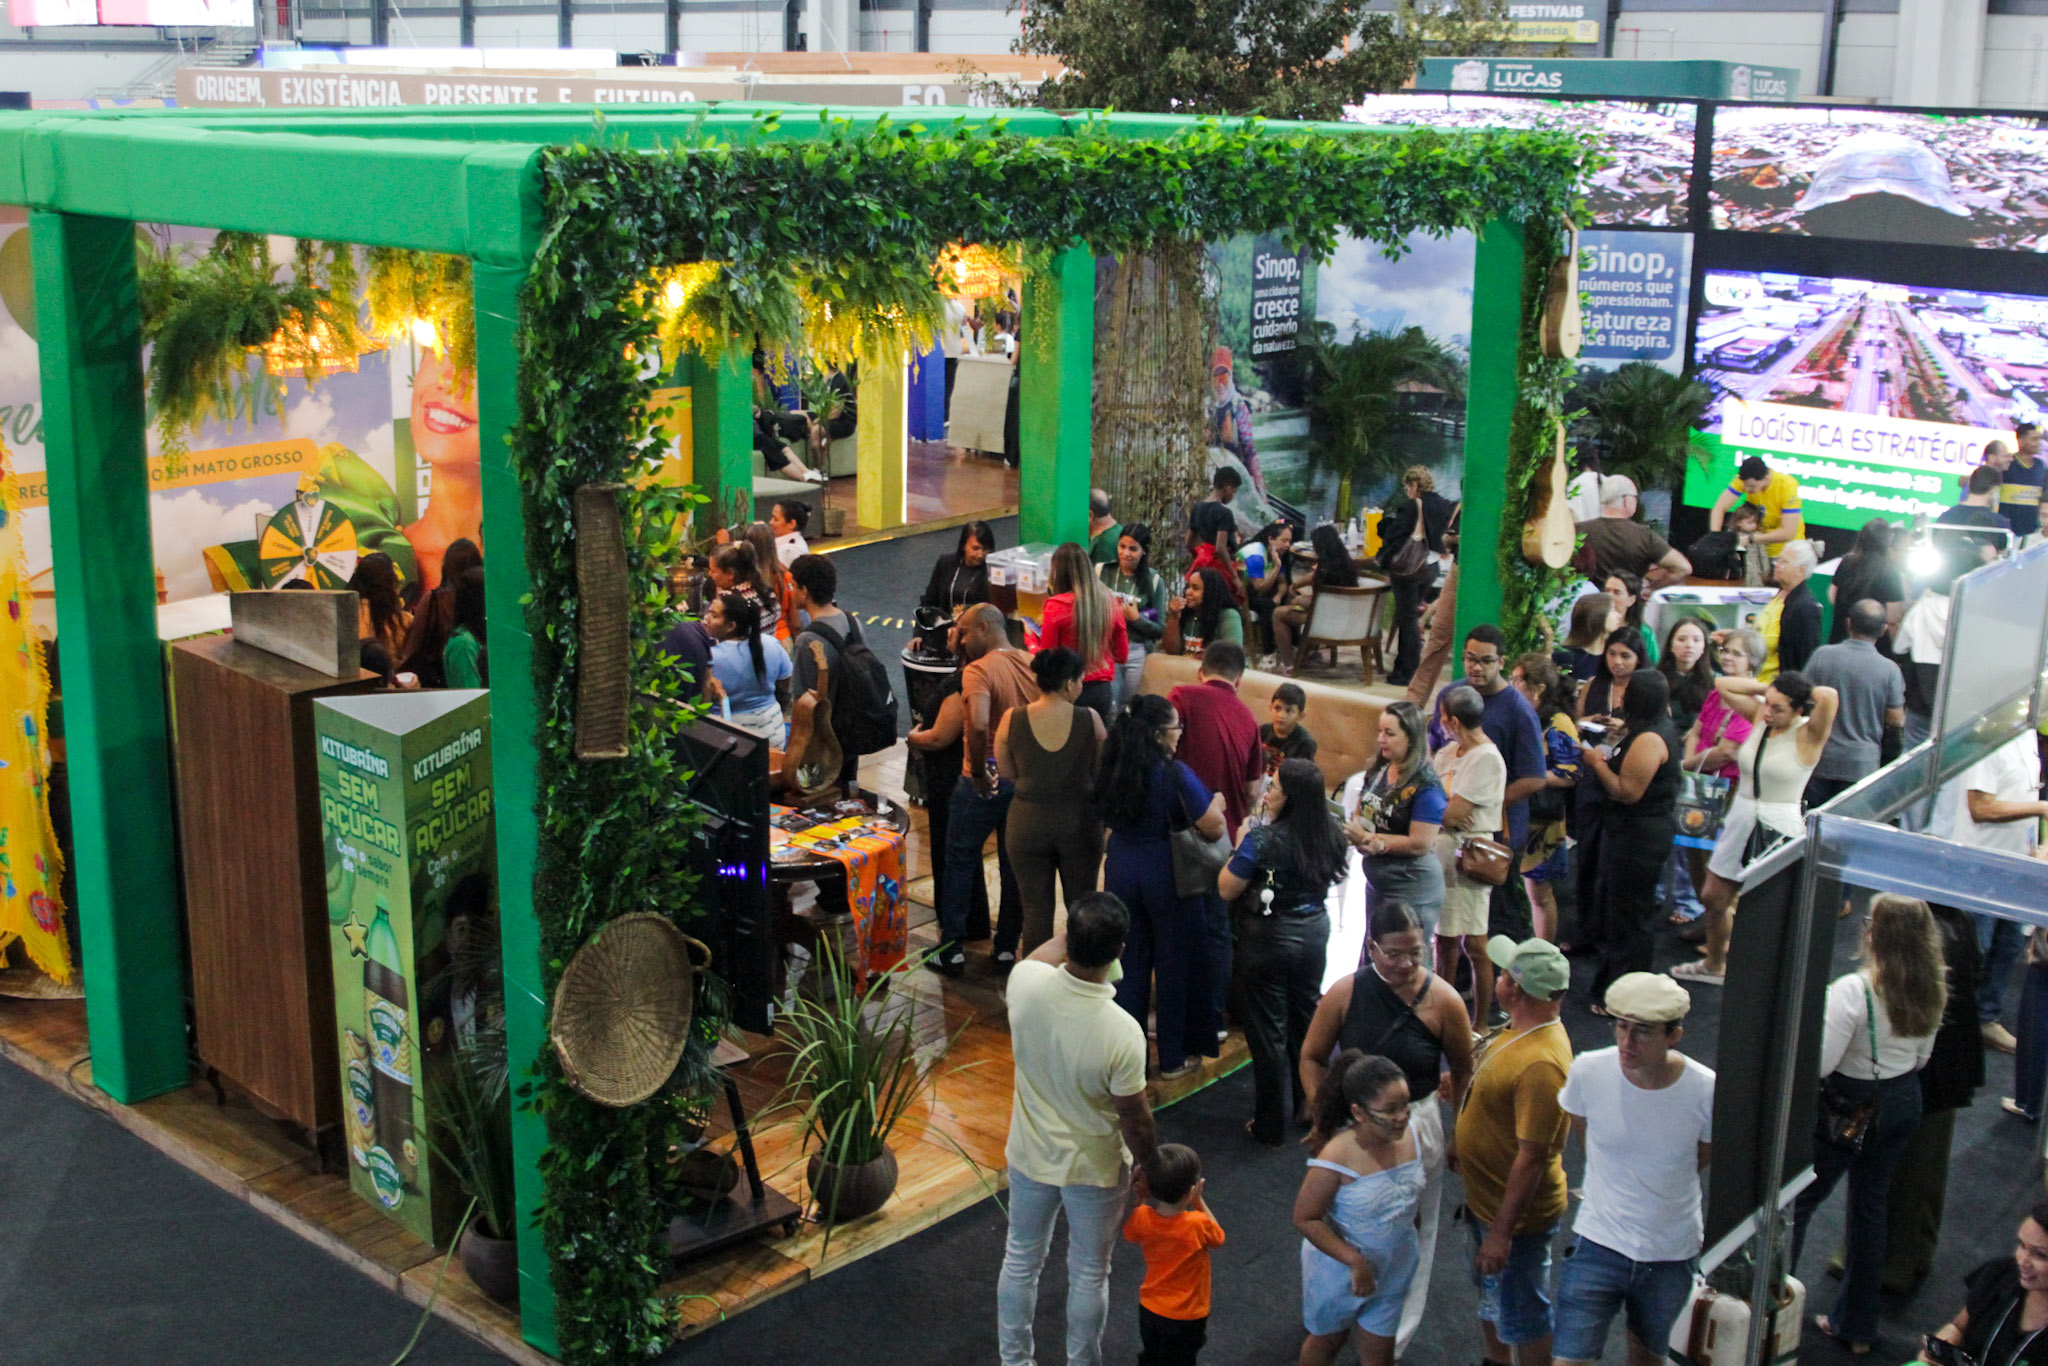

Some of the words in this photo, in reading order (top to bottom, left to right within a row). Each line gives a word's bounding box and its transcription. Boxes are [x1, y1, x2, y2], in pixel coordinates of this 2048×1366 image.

[1509, 4, 1585, 19] FESTIVAIS
[195, 75, 266, 107] ORIGEM,
[1493, 71, 1563, 88] LUCAS
[1753, 78, 1787, 96] LUCAS
[1255, 252, 1301, 283] Sinop,
[1581, 243, 1675, 280] Sinop,
[1578, 276, 1643, 293] números
[1645, 281, 1674, 297] que
[1253, 298, 1300, 320] cresce
[1579, 293, 1674, 308] pressionam.
[1252, 317, 1298, 339] cuidando
[1252, 341, 1263, 355] da
[1609, 331, 1671, 351] inspira.
[1738, 412, 1844, 450] LOGÍSTICA
[193, 458, 238, 476] MATO
[241, 450, 304, 470] GROSSO
[337, 769, 379, 813] SEM
[431, 762, 472, 808] SEM
[325, 795, 401, 857] AÇÚCAR
[415, 788, 491, 857] AÇÚCAR
